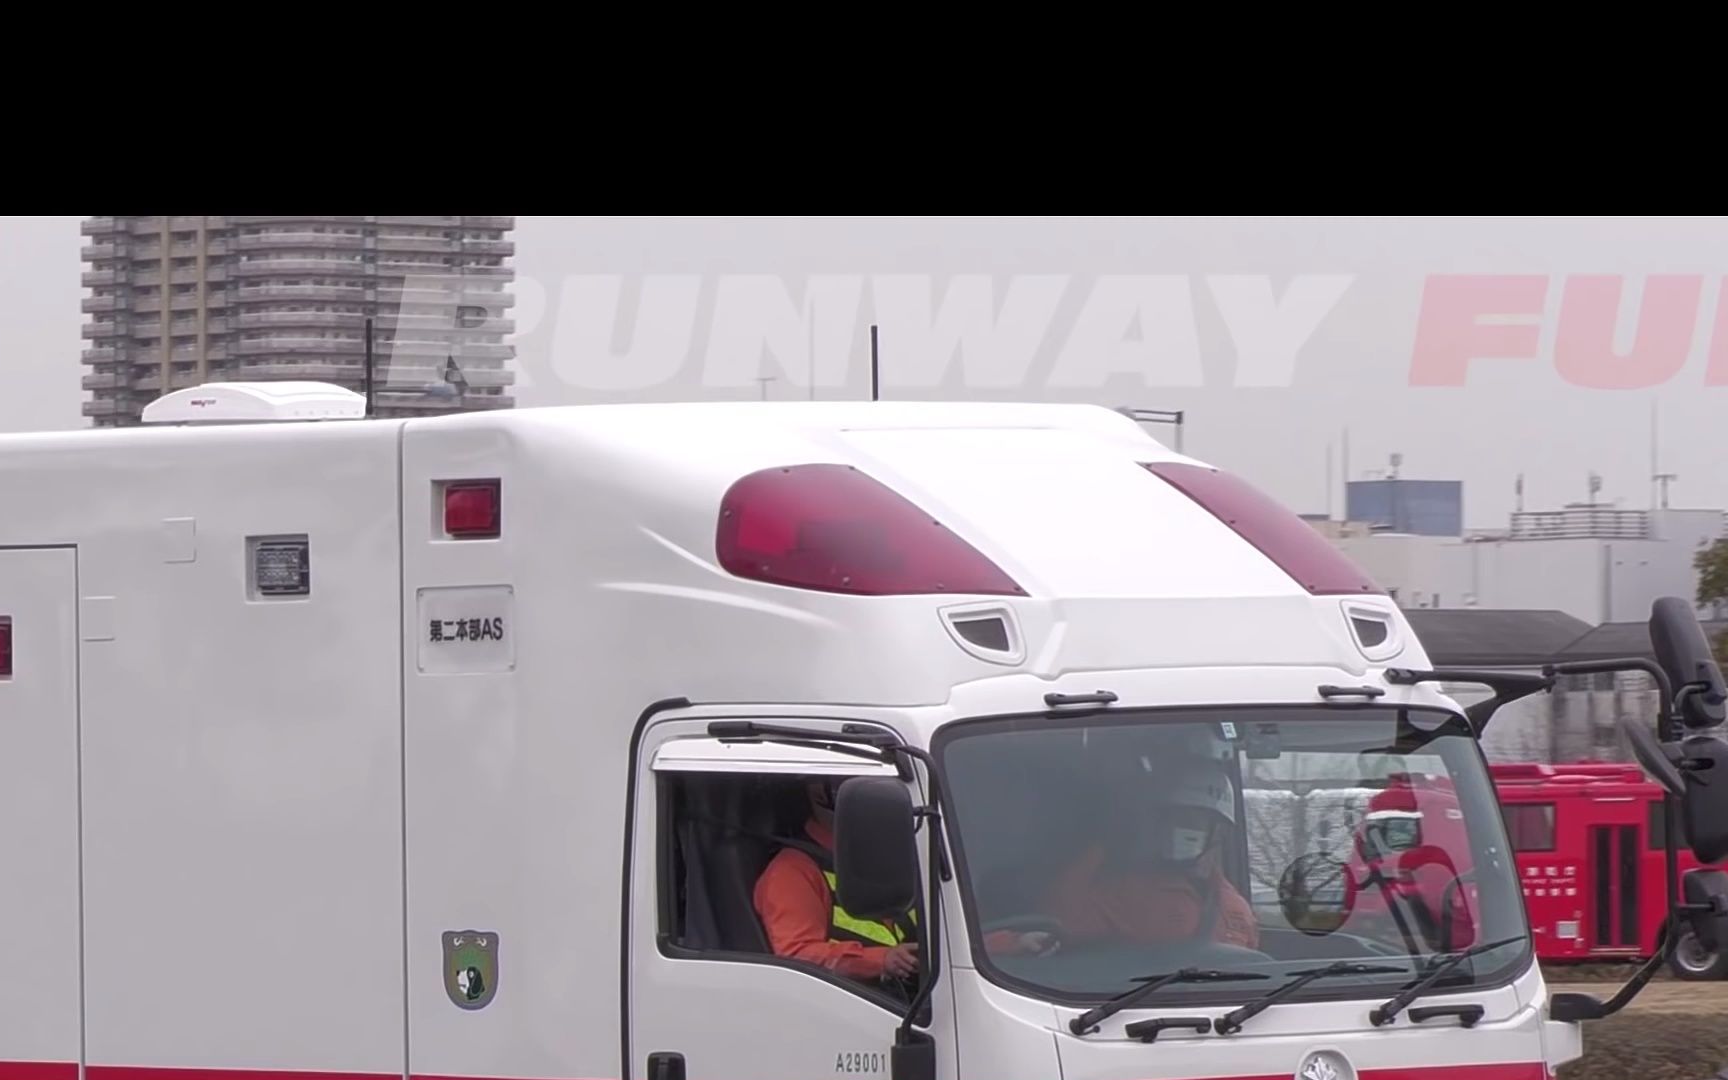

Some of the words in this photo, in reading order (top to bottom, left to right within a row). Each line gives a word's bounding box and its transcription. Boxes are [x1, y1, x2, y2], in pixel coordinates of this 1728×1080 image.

[429, 617, 504, 643] 第二本部AS
[835, 1052, 886, 1073] A29001
